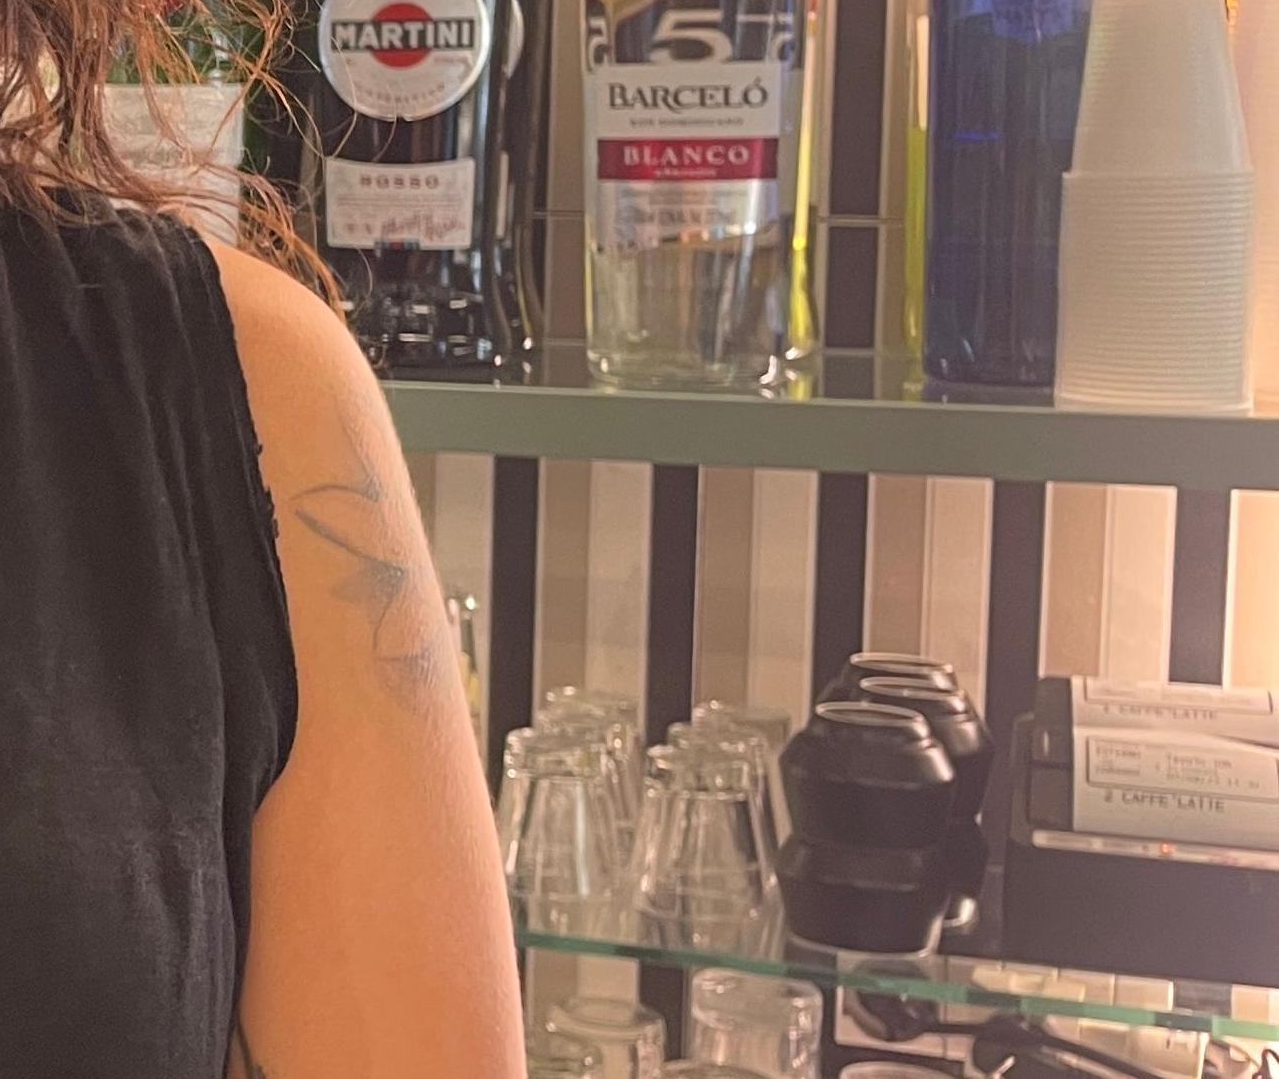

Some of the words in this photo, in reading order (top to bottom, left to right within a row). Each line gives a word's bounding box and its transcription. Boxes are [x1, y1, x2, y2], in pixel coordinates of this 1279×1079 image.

[334, 21, 470, 50] MARTINI
[609, 76, 768, 114] BARCELÓ
[624, 144, 749, 166] BLANCO
